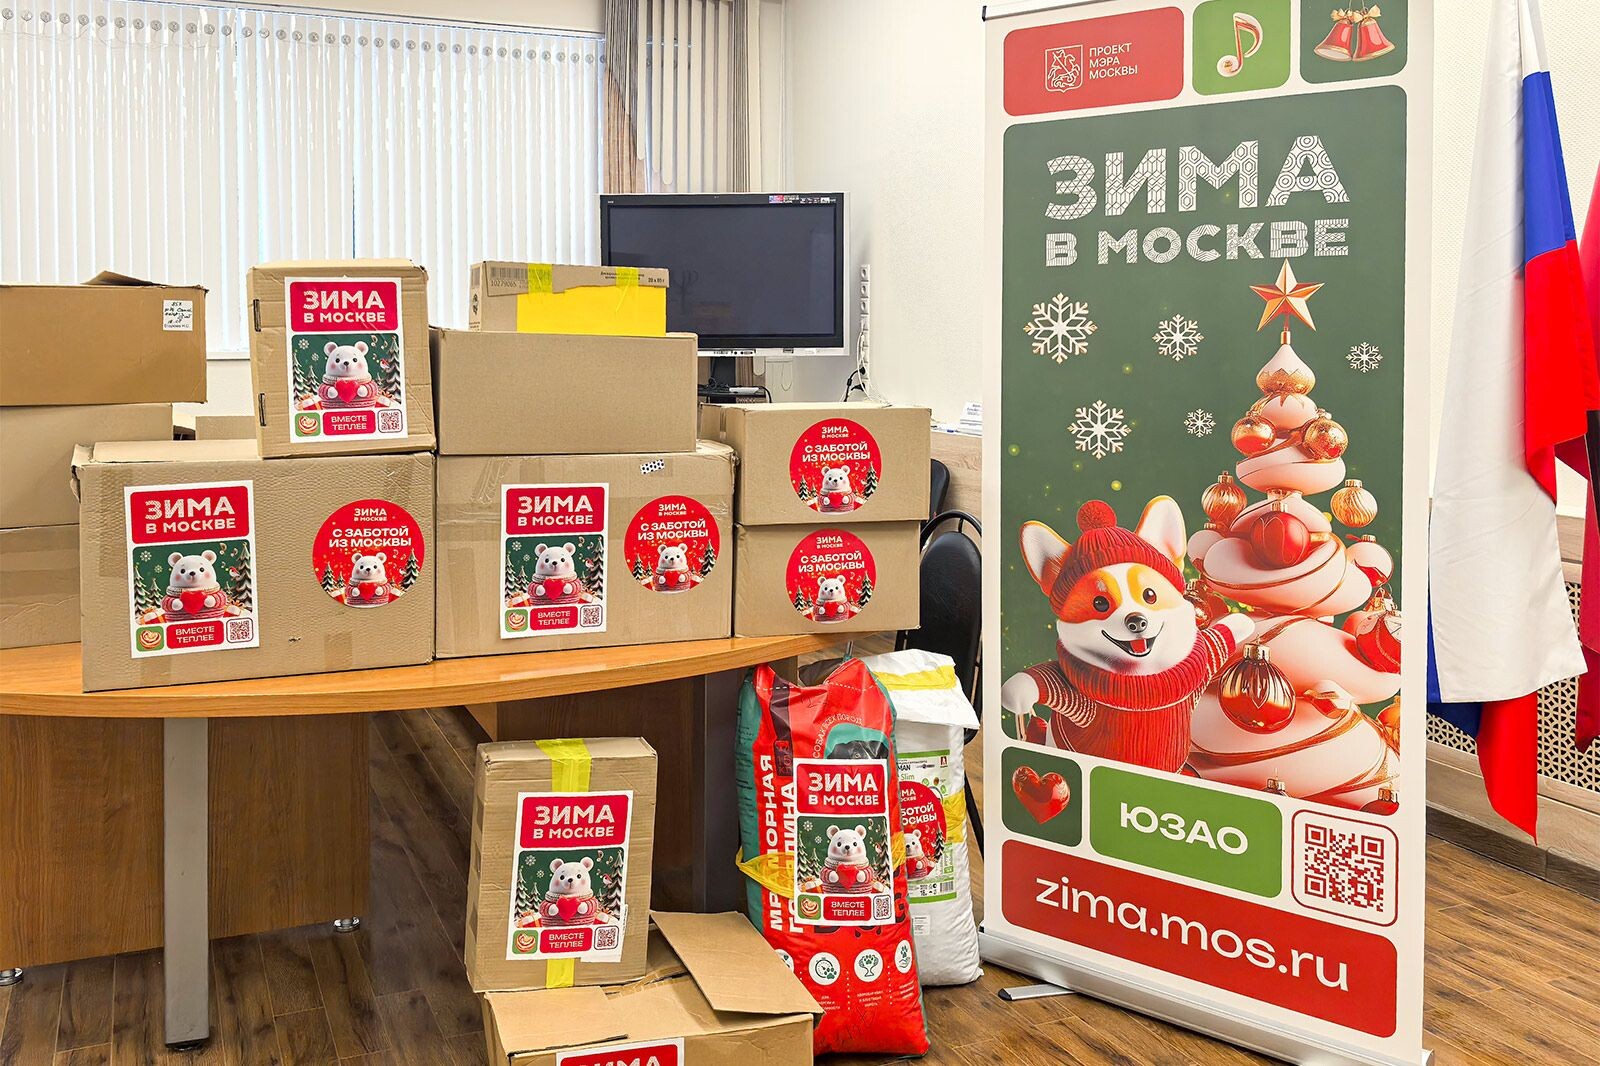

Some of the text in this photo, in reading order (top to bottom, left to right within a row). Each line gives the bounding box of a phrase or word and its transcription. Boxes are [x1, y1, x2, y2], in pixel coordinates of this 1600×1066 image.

[1089, 42, 1132, 57] ПРОЕКТ
[1089, 56, 1120, 68] МЭРА
[1089, 64, 1138, 80] МОСКВЫ
[1044, 135, 1350, 221] ЗИМА
[1045, 218, 1349, 267] В МОСКВЕ
[303, 290, 385, 310] ЗИМА
[303, 312, 386, 323] В МОСКВЕ
[330, 415, 367, 423] ВМЕСТЕ
[332, 423, 367, 431] ТЕПЛЕЕ
[821, 426, 849, 434] ЗИМА
[805, 441, 868, 453] С ЗАБОТОЙ
[802, 452, 870, 462] ИЗ МОСКВЫ
[145, 496, 236, 520] ЗИМА
[517, 495, 593, 514] ЗИМА
[658, 503, 687, 512] ЗИМА
[354, 508, 387, 517] ЗИМА
[146, 518, 236, 534] В МОСКВЕ
[518, 515, 593, 527] В МОСКВЕ
[640, 518, 706, 531] С ЗАБОТОЙ
[332, 525, 409, 537] С ЗАБОТОЙ
[638, 529, 708, 541] ИЗ МОСКВЫ
[329, 537, 412, 548] ИЗ МОСКВЫ
[816, 536, 843, 544] ЗИМА
[800, 550, 862, 564] С ЗАБОТОЙ
[798, 561, 865, 573] ИЗ МОСКВЫ
[537, 610, 571, 619] ВМЕСТЕ
[538, 618, 569, 626] ТЕПЛЕЕ
[175, 626, 215, 636] ВМЕСТЕ
[177, 634, 215, 644] ТЕПЛЕЕ
[808, 772, 878, 793] ЗИМА
[901, 788, 916, 797] МА
[808, 794, 879, 806] В МОСКВЕ
[534, 804, 616, 825] ЗИМА
[901, 802, 934, 816] БОТОЙ
[902, 813, 937, 826] ОСКВЫ
[533, 825, 615, 839] В МОСКВЕ
[1120, 802, 1249, 855] ЮЗАО
[831, 901, 865, 909] ВМЕСТЕ
[832, 909, 865, 917] ТЕПЛЕЕ
[548, 932, 585, 941] ВМЕСТЕ
[1035, 876, 1350, 992] zima.mos.ru
[549, 940, 583, 949] ТЕПЛЕЕ
